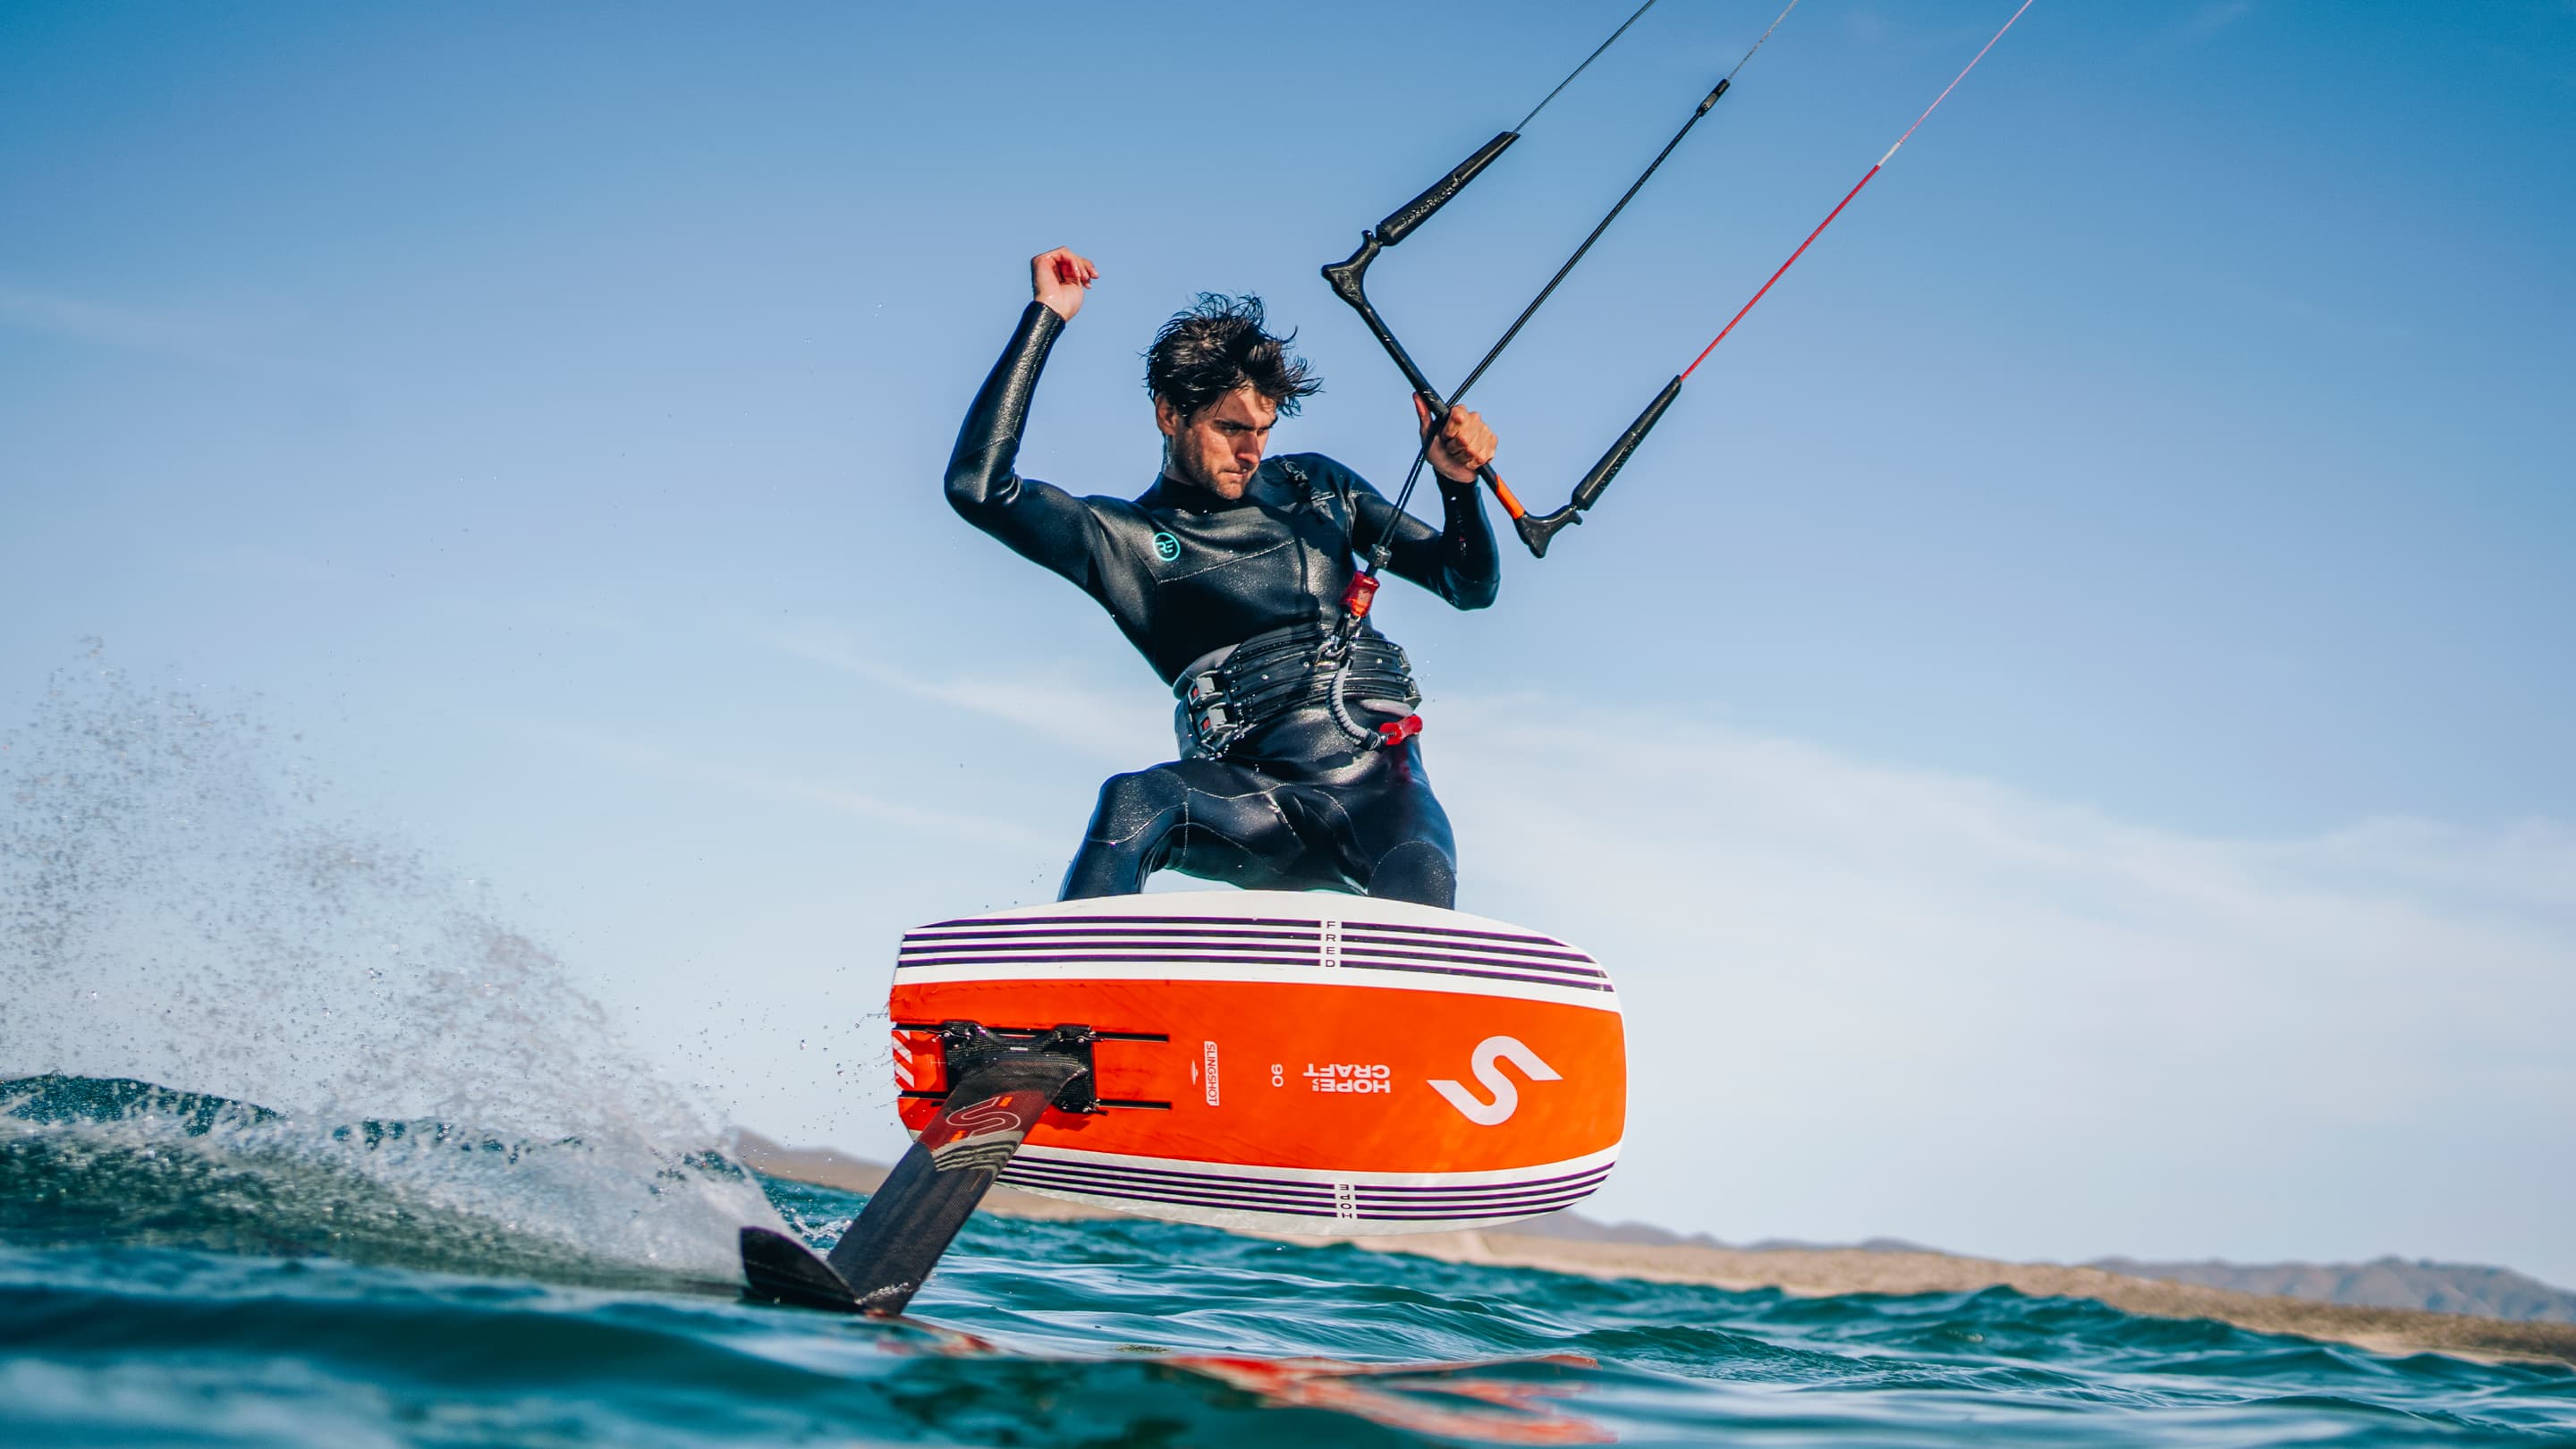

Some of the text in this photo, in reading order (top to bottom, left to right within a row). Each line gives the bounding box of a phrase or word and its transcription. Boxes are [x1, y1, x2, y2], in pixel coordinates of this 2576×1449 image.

[1326, 920, 1336, 968] FRED
[1206, 1043, 1218, 1105] SLINGSHOT
[1270, 1063, 1284, 1088] 90
[1302, 1063, 1391, 1079] CRAFT
[1319, 1078, 1391, 1093] HOPE
[1339, 1183, 1353, 1220] HOPE
